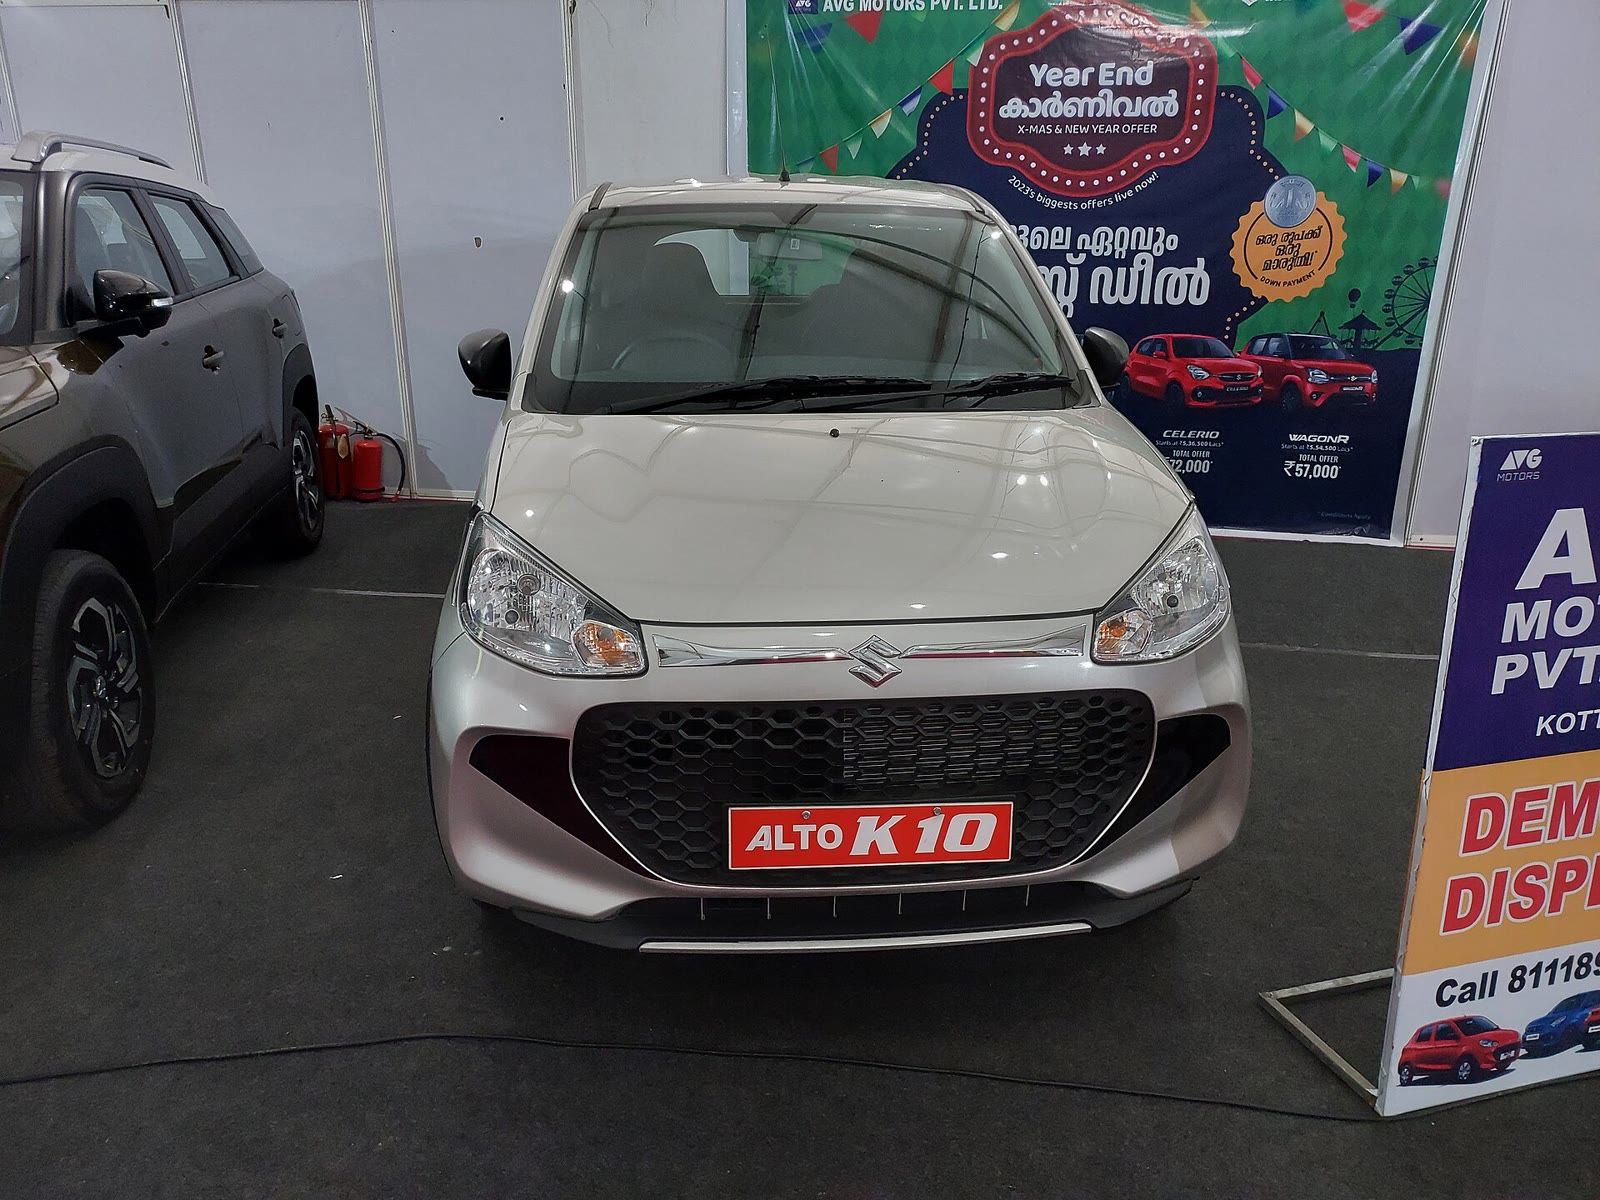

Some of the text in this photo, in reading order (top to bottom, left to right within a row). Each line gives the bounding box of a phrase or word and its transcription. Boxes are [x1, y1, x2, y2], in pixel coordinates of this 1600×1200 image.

[822, 0, 854, 12] AVG
[859, 0, 926, 11] MOTORS
[930, 0, 964, 11] PVT.
[968, 0, 1003, 10] LTD.
[1029, 60, 1154, 87] Year End
[999, 88, 1179, 119] കാർണിവൽ
[1017, 123, 1158, 135] X-MAS & NEW YEAR OFFER
[1007, 171, 1160, 210] 2023's biggests offers live now!
[1076, 225, 1179, 259] ഏറ്റവും
[1089, 251, 1211, 306] ഡീൽ
[1260, 269, 1316, 287] DOWN PAYMENT
[1162, 429, 1220, 439] CELERIO
[1288, 433, 1350, 444] WAGONR
[1172, 449, 1211, 458] TOTAL OFFER
[1299, 454, 1339, 463] TOTAL OFFER
[1500, 448, 1543, 470] AVG
[1496, 471, 1540, 482] MOTORS
[1501, 595, 1600, 643] MO
[1491, 645, 1600, 695] PVT
[745, 823, 843, 852] ALTO
[1435, 970, 1498, 1008] Call
